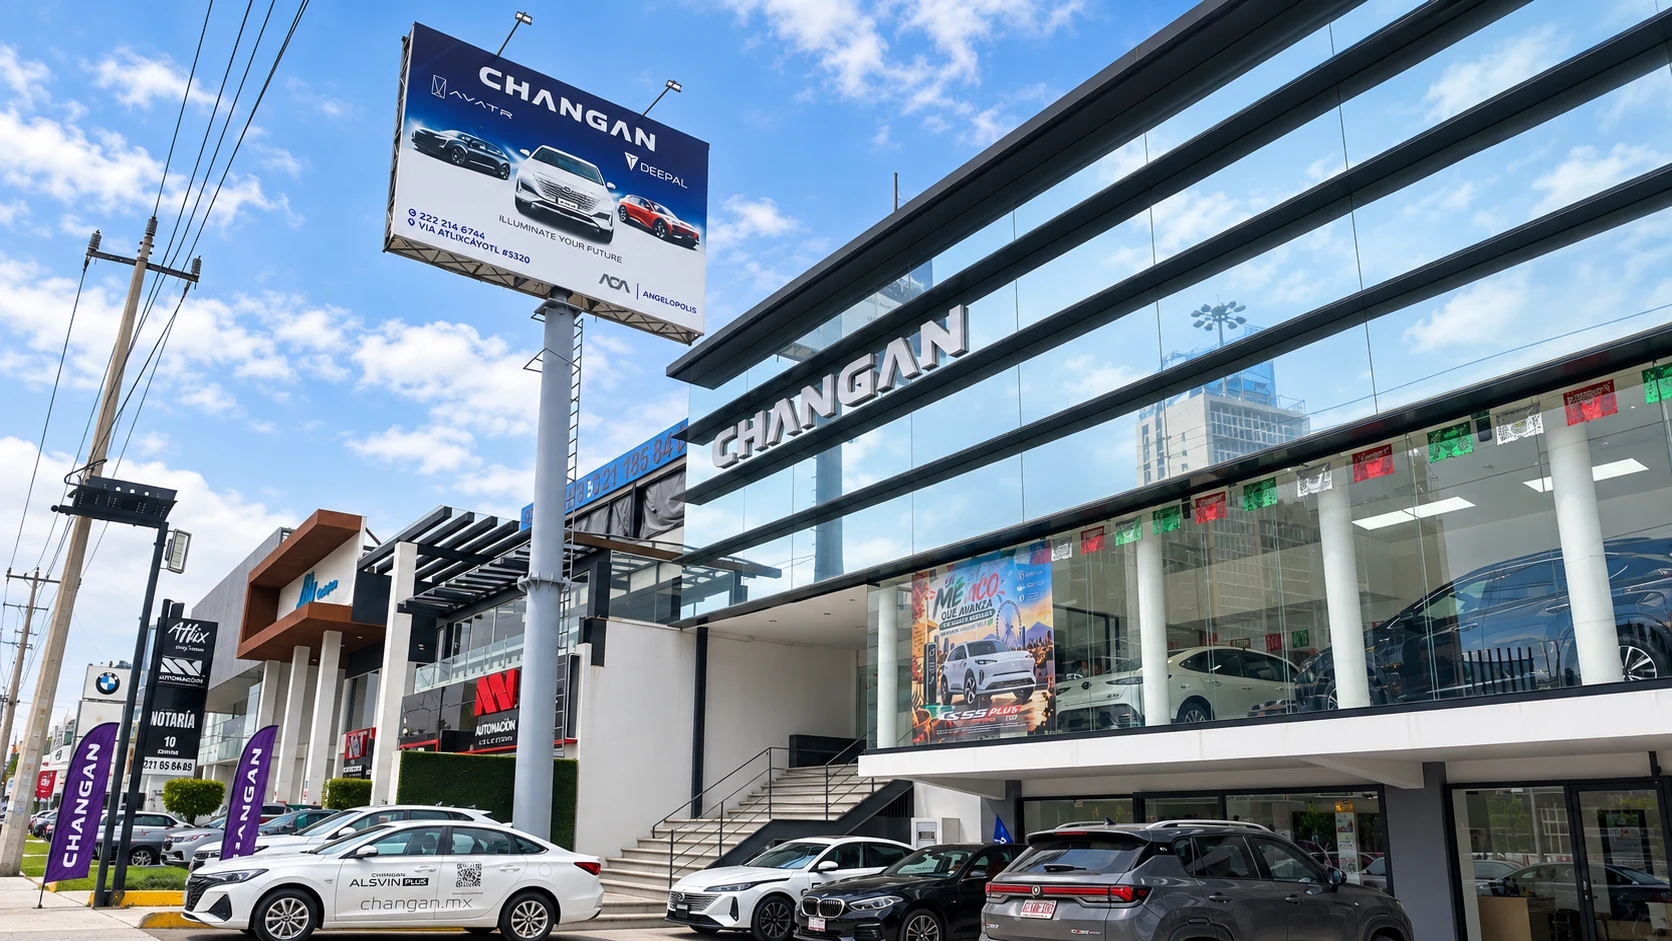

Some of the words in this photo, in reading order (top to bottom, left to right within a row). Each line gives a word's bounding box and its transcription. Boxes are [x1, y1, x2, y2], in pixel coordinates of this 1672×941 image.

[449, 90, 514, 120] AVATR
[479, 66, 656, 152] CHANGAN
[640, 162, 688, 189] DEEPAL
[419, 221, 436, 234] VIA
[437, 228, 500, 254] ATLIXCÁYOTL
[420, 212, 439, 224] 222
[441, 219, 458, 231] 214
[460, 225, 486, 240] 6744
[499, 214, 557, 241] ILLUMINATE
[558, 235, 585, 251] YOUR
[587, 243, 623, 264] FUTURE
[642, 290, 697, 314] ANGELOPOLIS
[711, 304, 970, 469] CHANGAN
[622, 446, 649, 480] 185
[958, 598, 993, 617] AVANZA
[150, 710, 195, 729] NOTARÍA
[164, 736, 177, 748] 10
[62, 743, 102, 869] CHANGAN
[349, 878, 401, 887] ALSVIN
[403, 878, 429, 887] PLUS
[360, 897, 473, 913] changan.mx
